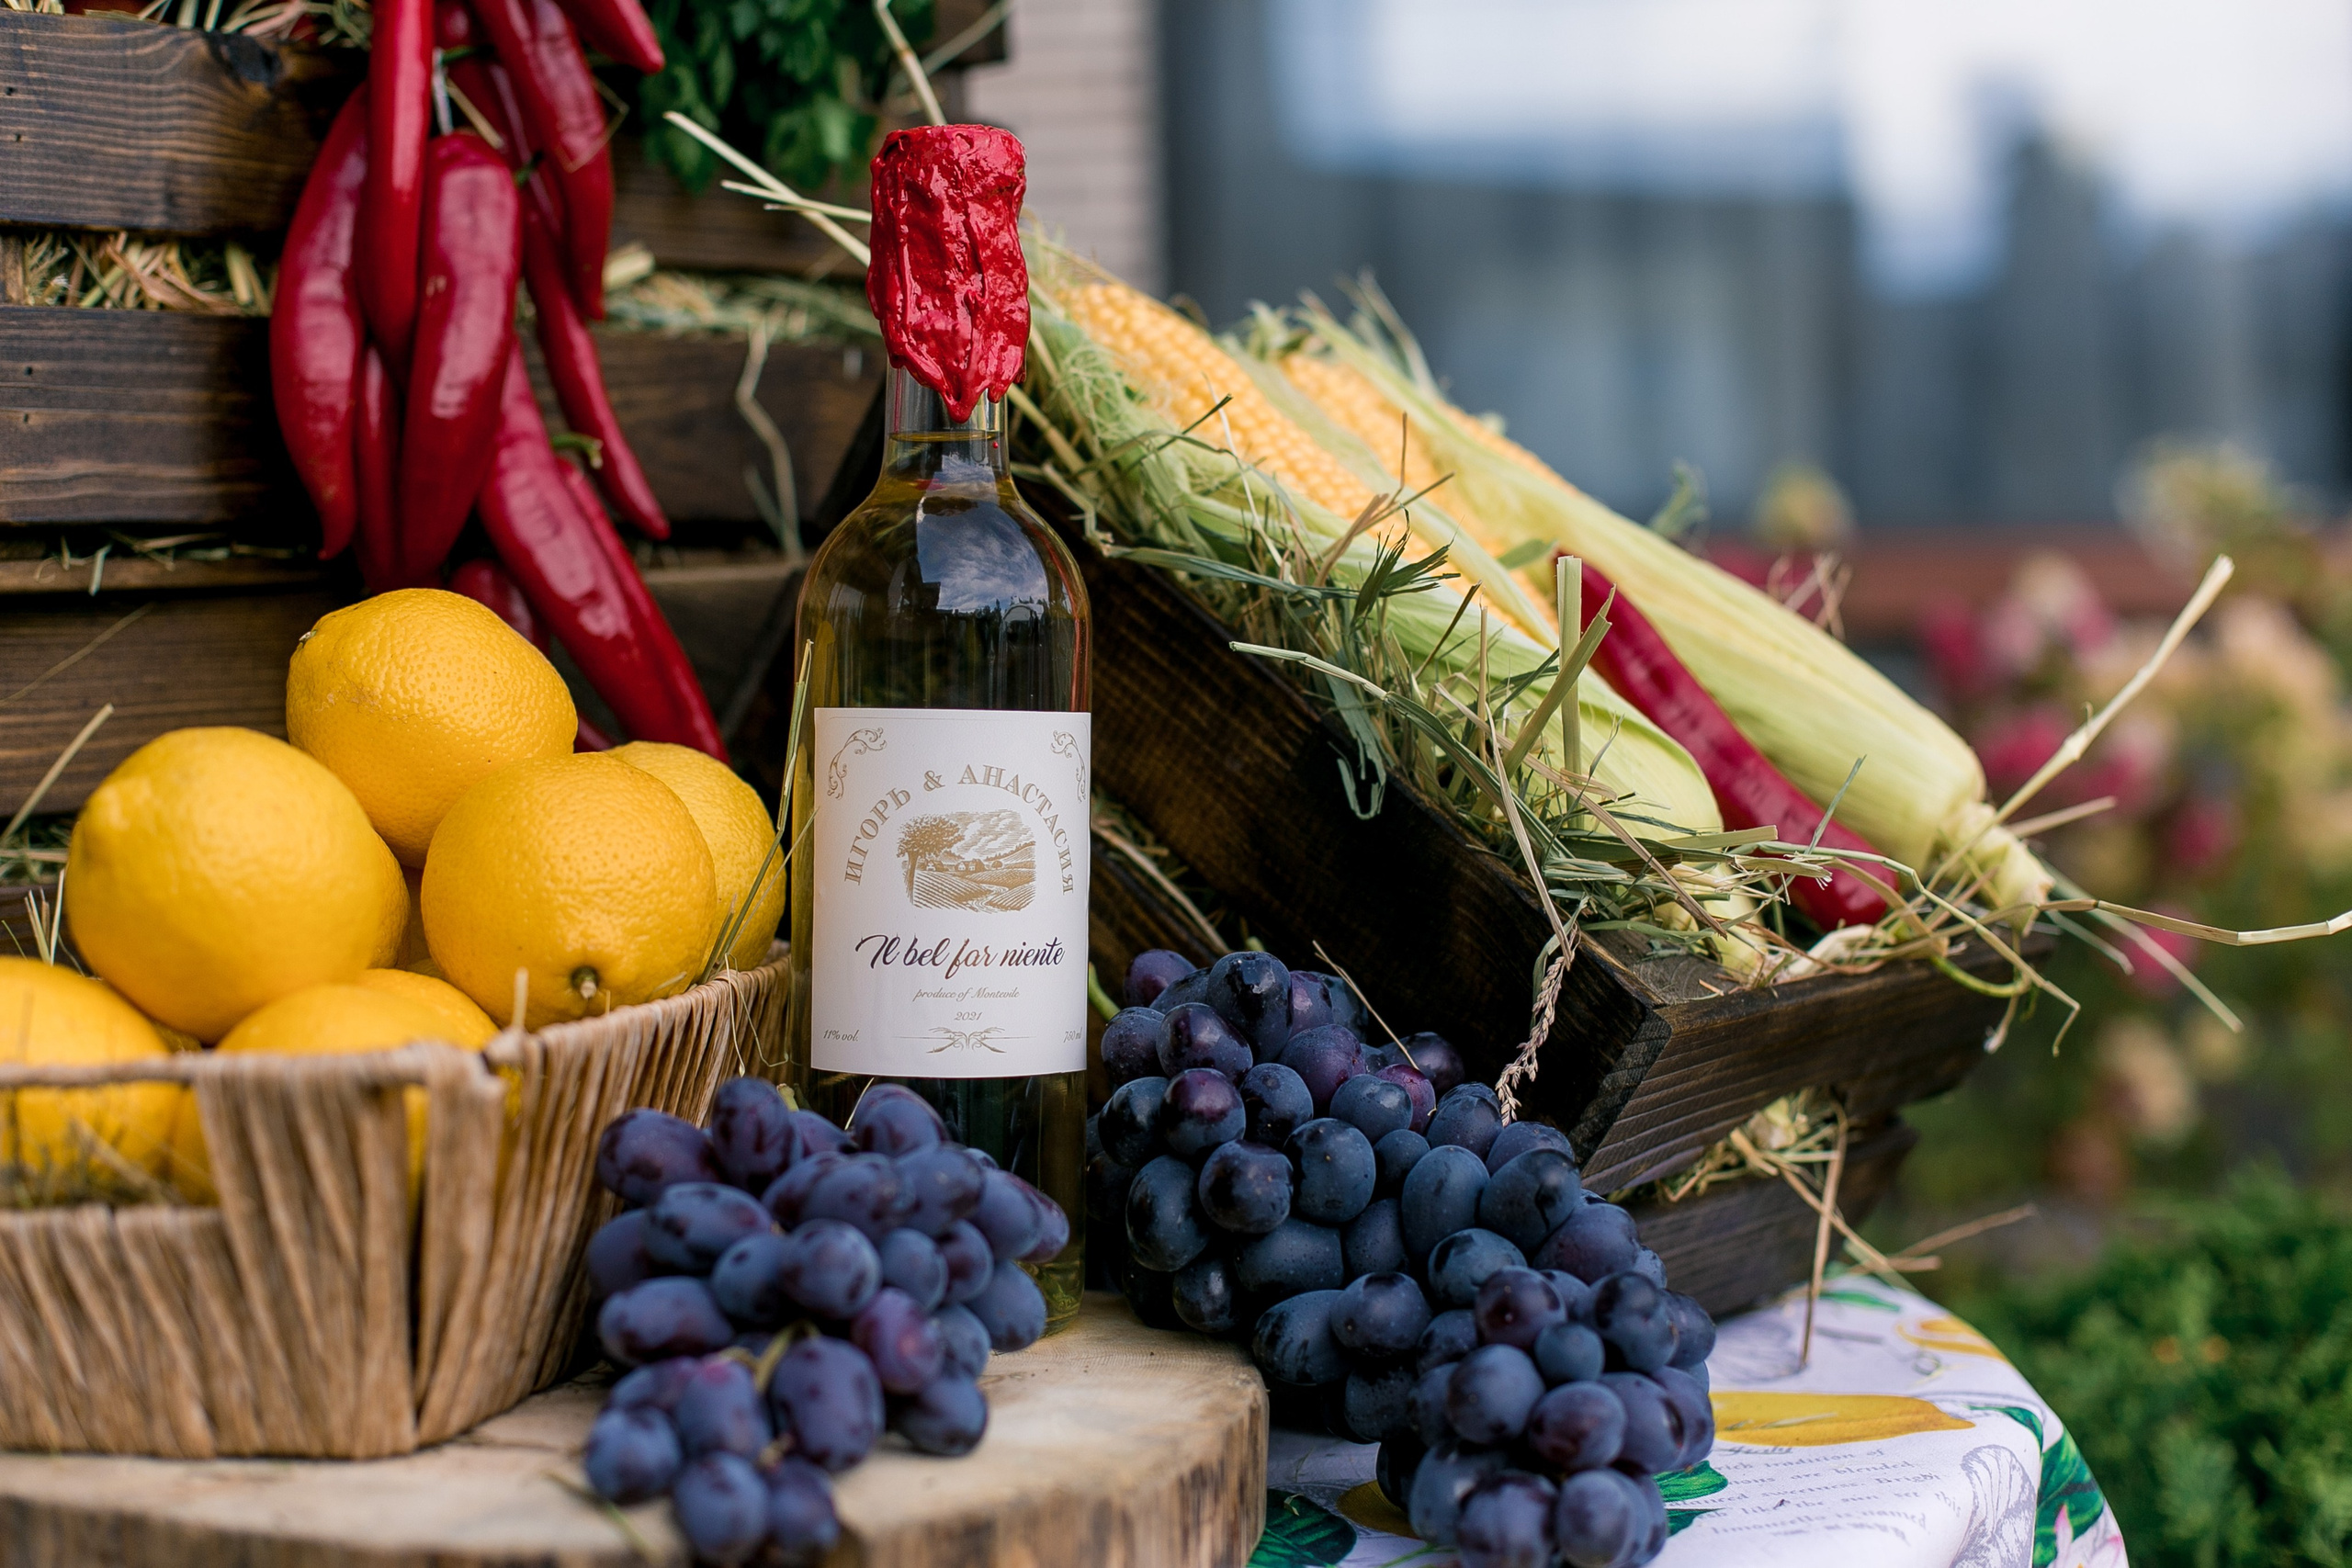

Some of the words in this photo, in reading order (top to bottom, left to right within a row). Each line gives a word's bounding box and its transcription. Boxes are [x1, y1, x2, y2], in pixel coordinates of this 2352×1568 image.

[844, 786, 911, 886] ИГОРЬ
[922, 770, 945, 792] &
[957, 764, 1074, 895] АНАСТАСИЯ
[903, 935, 951, 966] bel
[944, 937, 997, 980] far
[1000, 936, 1066, 967] niente
[912, 987, 956, 1002] produce
[956, 987, 973, 1002] of
[954, 1011, 983, 1021] 2021
[823, 1029, 841, 1040] 11%
